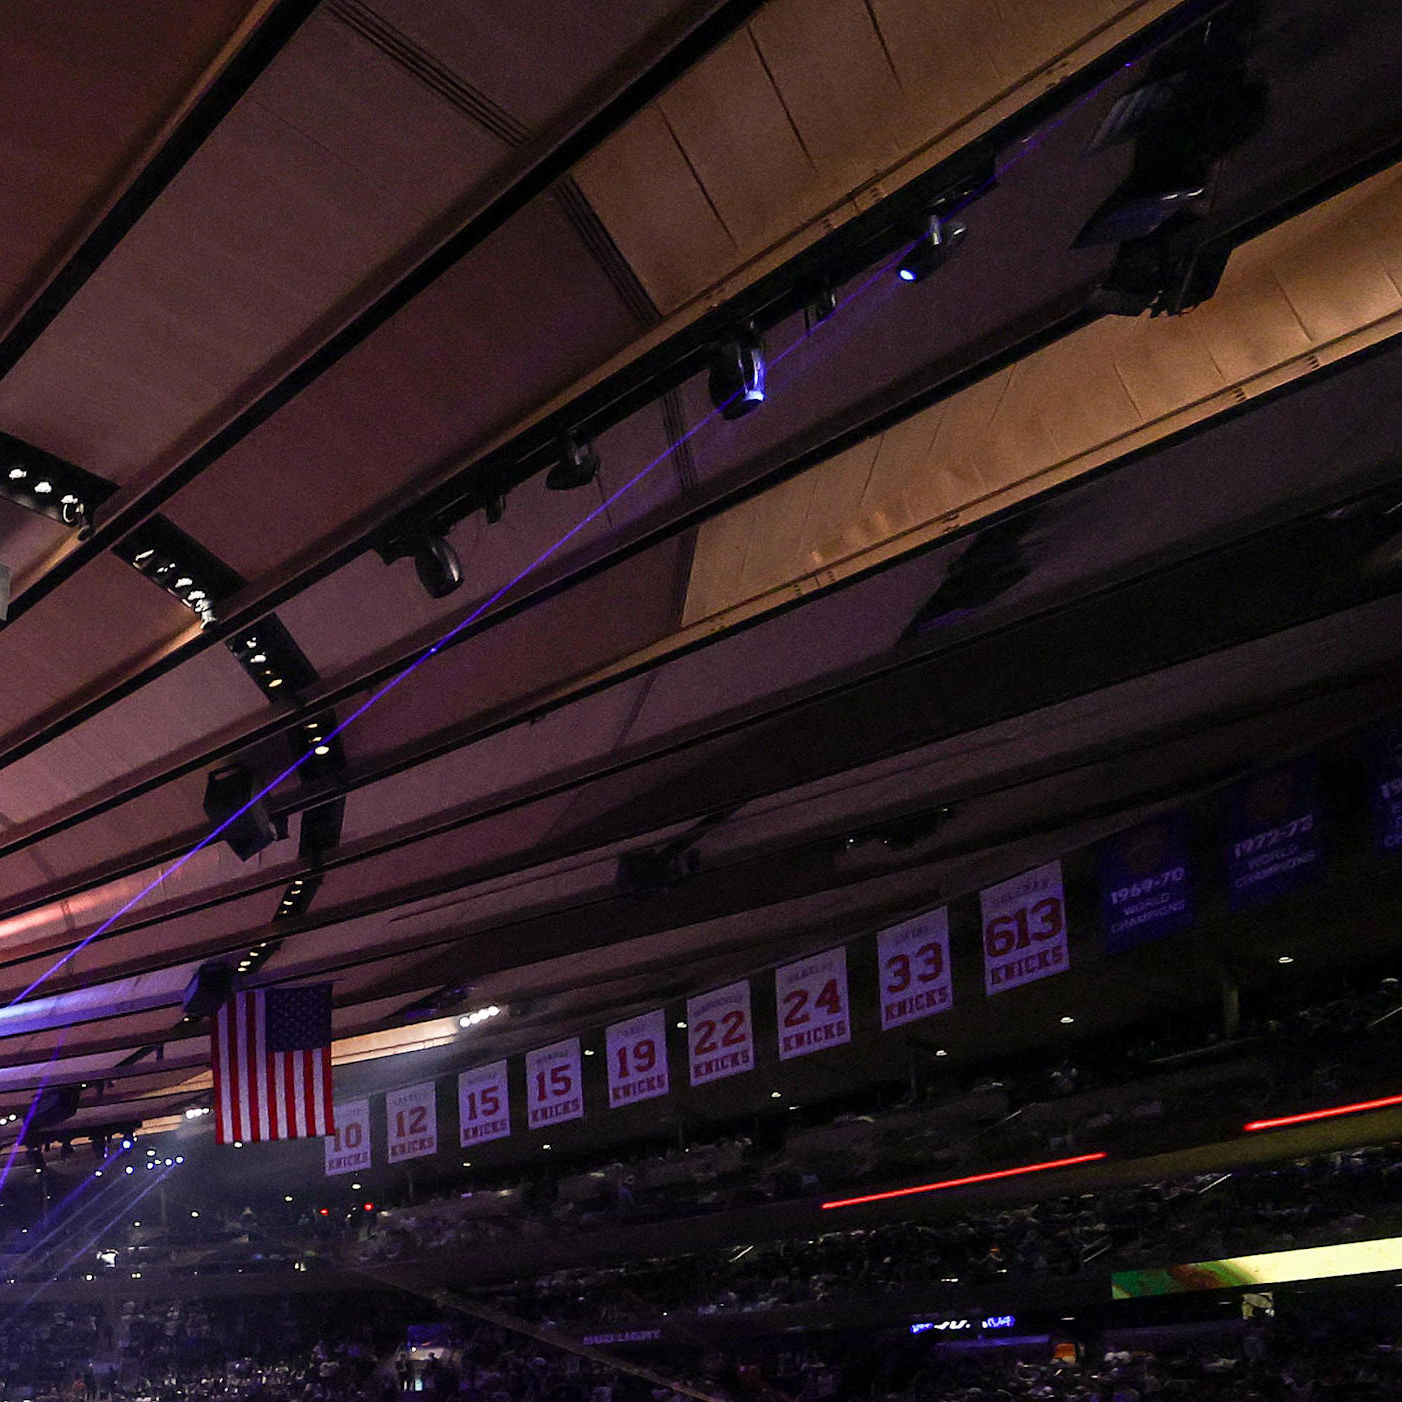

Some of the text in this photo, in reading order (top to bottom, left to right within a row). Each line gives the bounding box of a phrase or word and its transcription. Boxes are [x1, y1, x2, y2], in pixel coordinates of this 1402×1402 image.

[1234, 814, 1313, 858] 1972-73
[1111, 867, 1185, 906] 1969-70
[1110, 900, 1187, 934] CHAMPIONS
[1123, 892, 1171, 917] WORLD
[985, 897, 1064, 958] 613
[885, 942, 944, 994] 33
[990, 945, 1063, 986] KNICKS
[783, 978, 842, 1028] 24
[885, 985, 948, 1022] KNICKS
[695, 1009, 746, 1057] 22
[783, 1019, 846, 1052] KNICKS
[617, 1038, 656, 1080] 19
[693, 1049, 749, 1078] KNICKS
[536, 1064, 572, 1102] 15
[612, 1073, 665, 1102] KNICKS
[468, 1086, 500, 1121] 15
[531, 1098, 580, 1123] KNICKS
[335, 1122, 362, 1153] 10
[395, 1105, 427, 1138] 12
[463, 1119, 508, 1142] KNICKS
[328, 1151, 369, 1170] KNICKS
[391, 1136, 435, 1158] KNICKS
